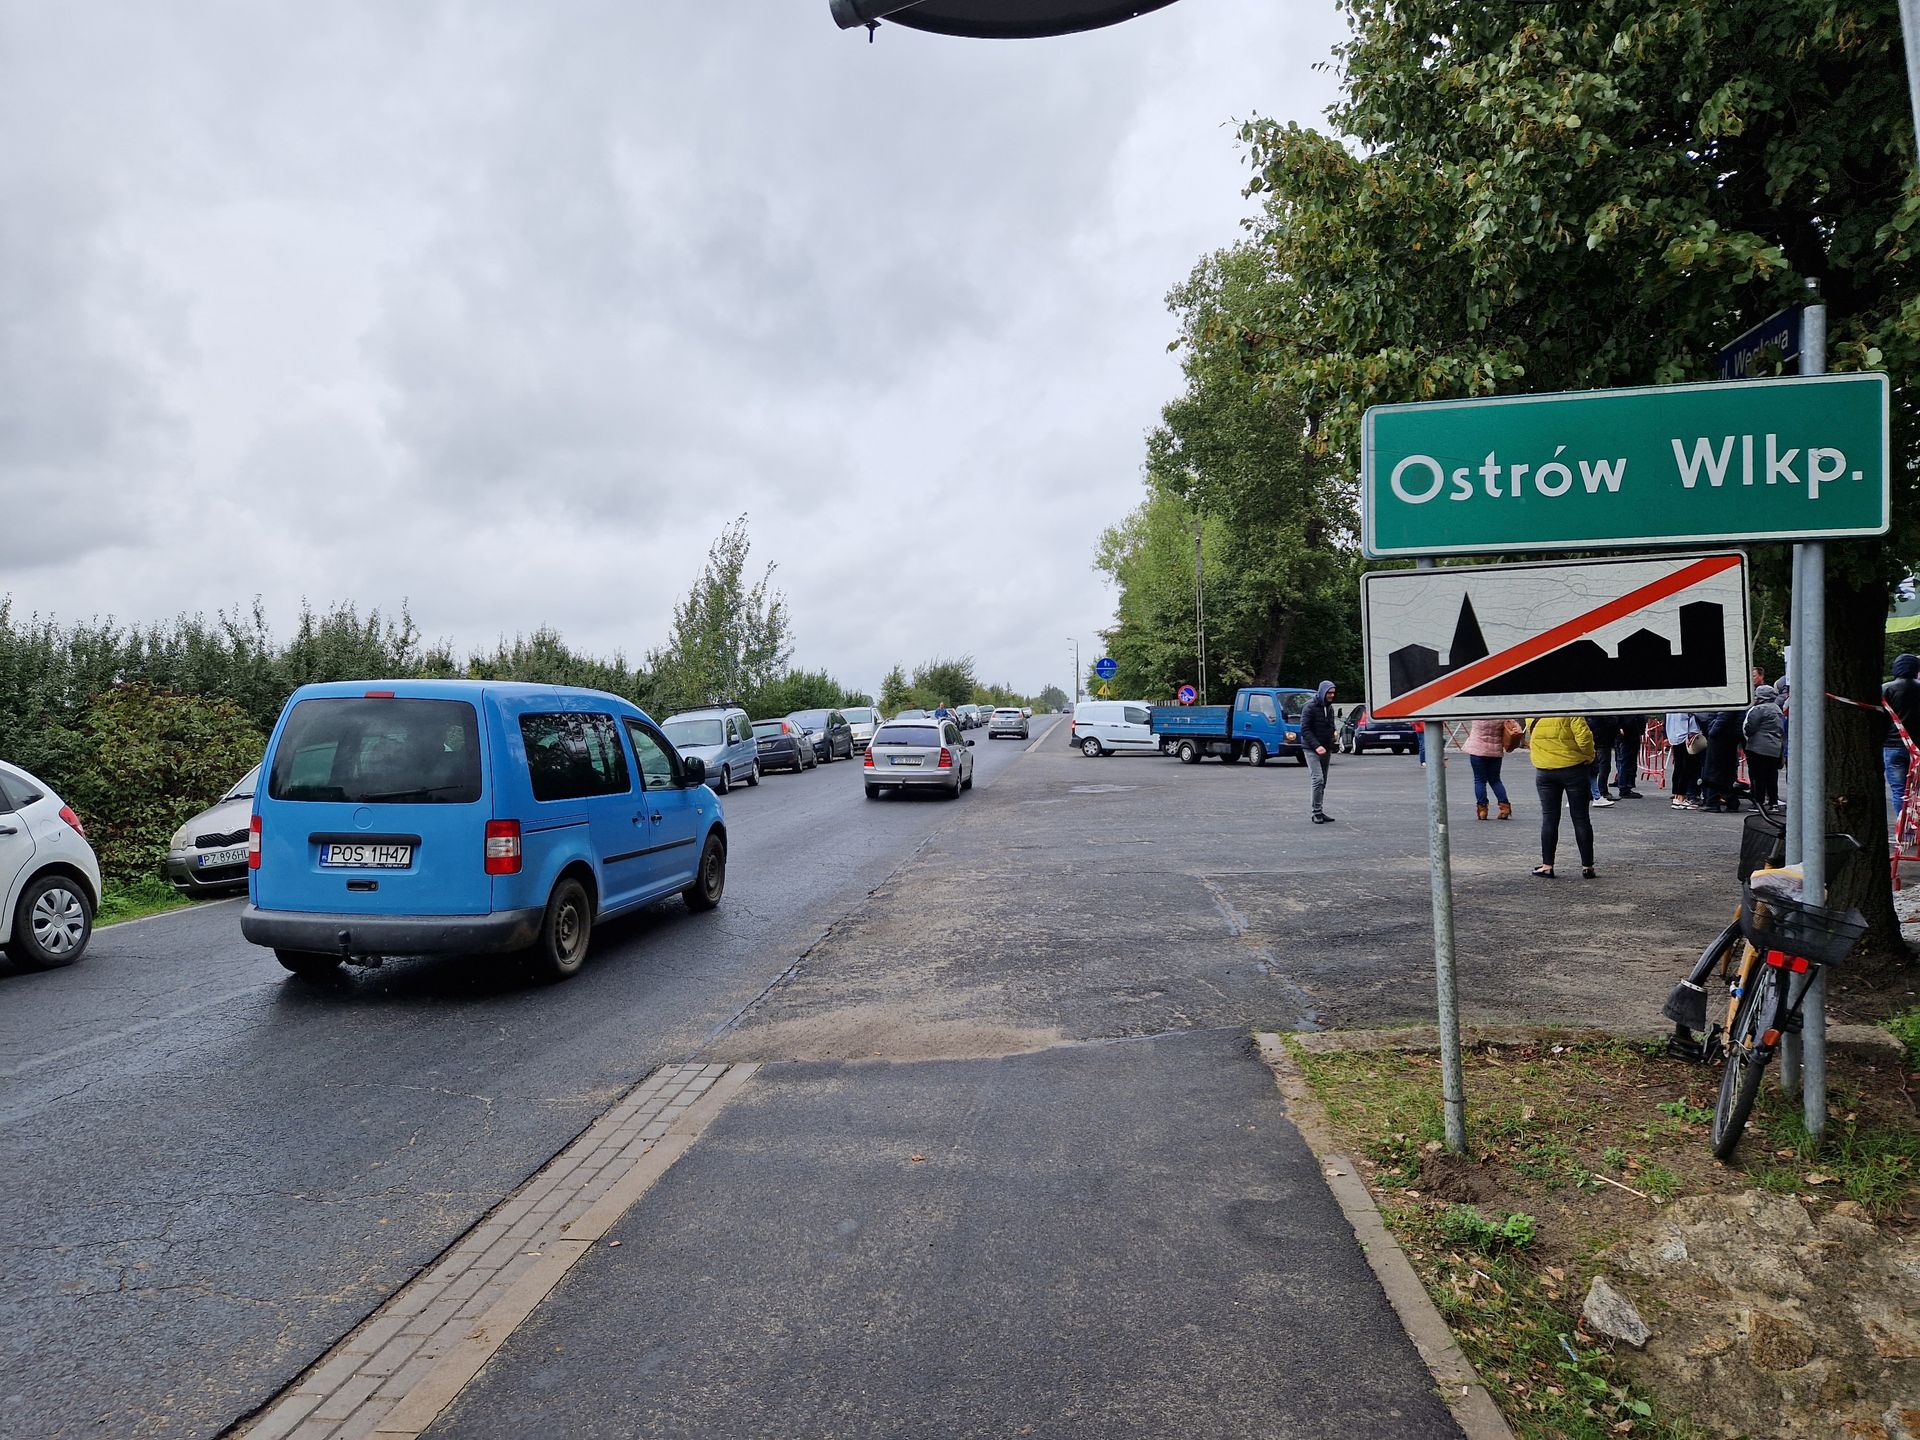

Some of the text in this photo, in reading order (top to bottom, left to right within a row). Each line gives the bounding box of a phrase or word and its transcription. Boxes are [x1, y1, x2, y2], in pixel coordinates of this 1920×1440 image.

[1391, 433, 1864, 504] Ostrów Wlkp.
[203, 854, 218, 865] PZ
[330, 845, 409, 863] POS 1H47
